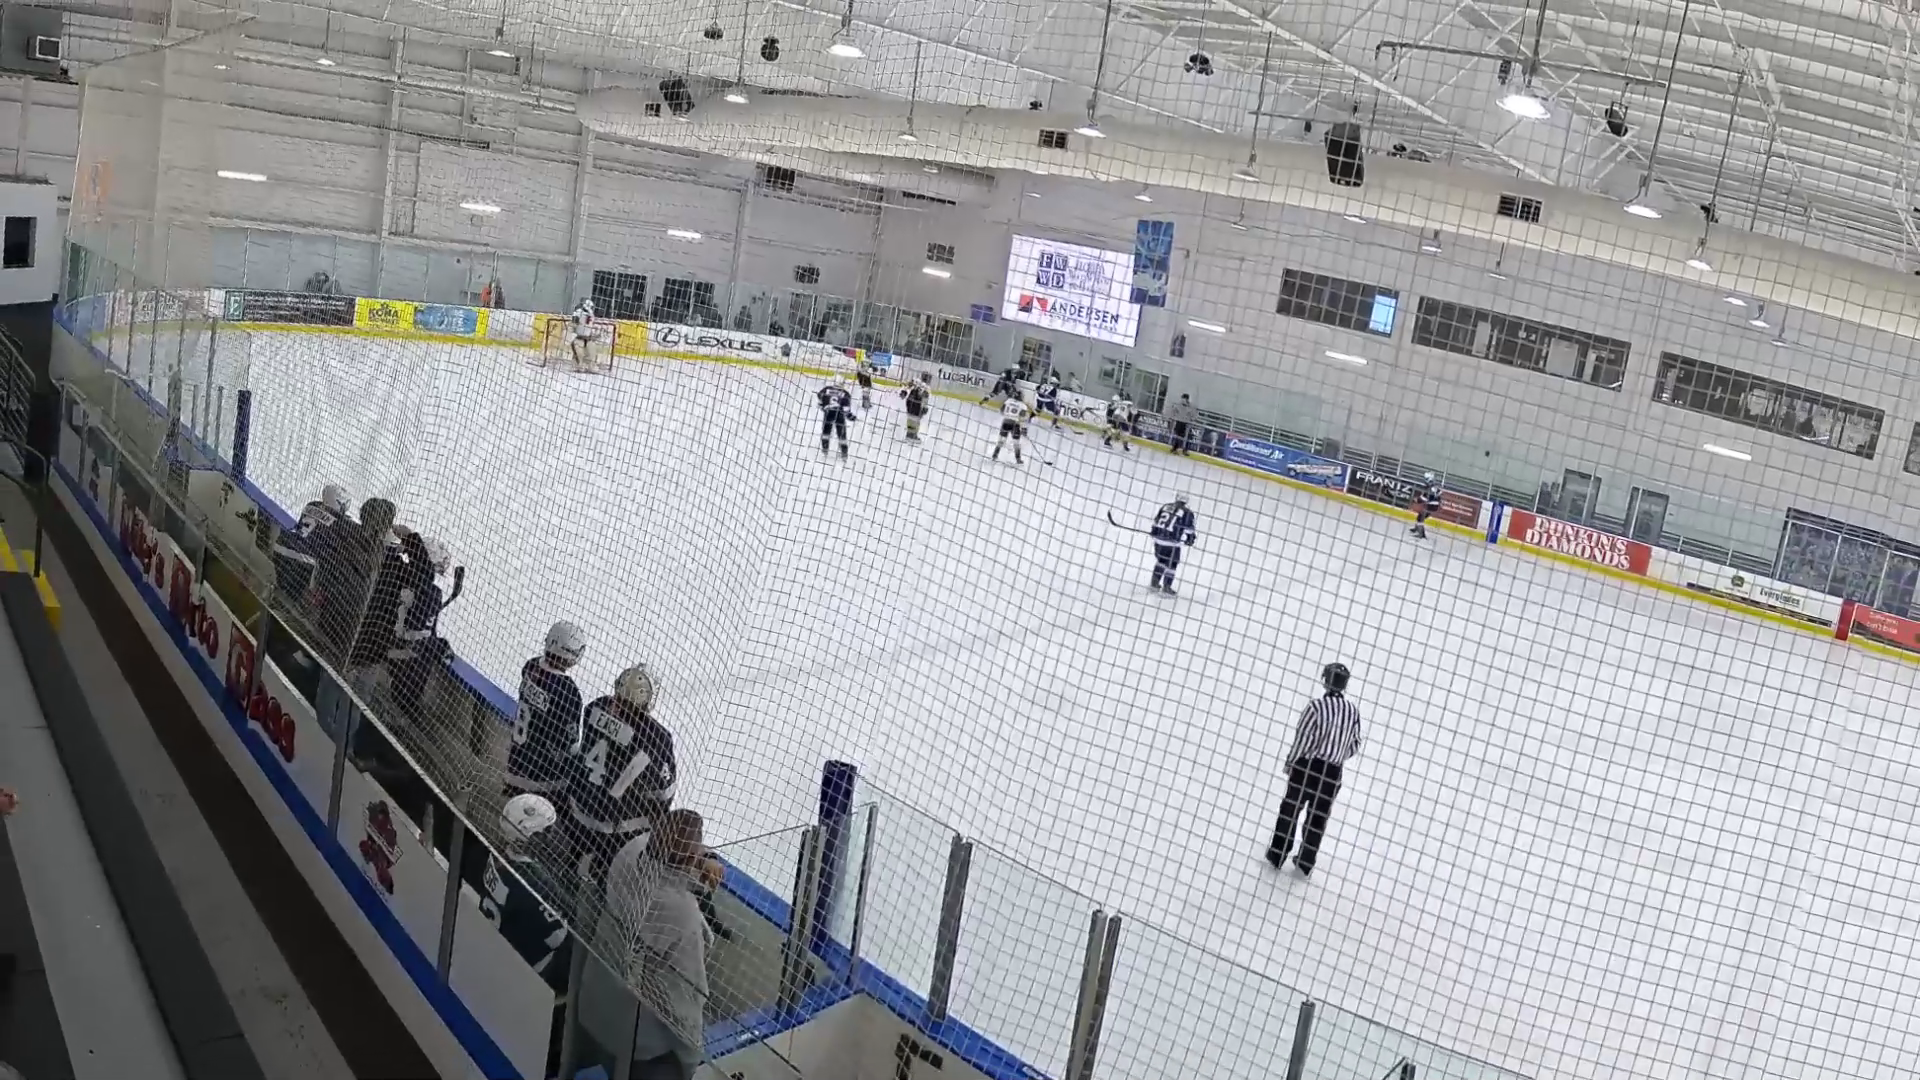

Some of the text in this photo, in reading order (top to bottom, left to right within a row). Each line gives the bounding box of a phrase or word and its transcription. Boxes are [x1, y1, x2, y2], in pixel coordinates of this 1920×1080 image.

[1050, 299, 1119, 324] ANDERSEN
[685, 333, 763, 353] LEXUS
[1356, 472, 1413, 494] FRANTZ
[1157, 512, 1178, 532] 21
[1533, 517, 1628, 555] DUNKIN'S
[1525, 529, 1631, 570] DIAMONDS
